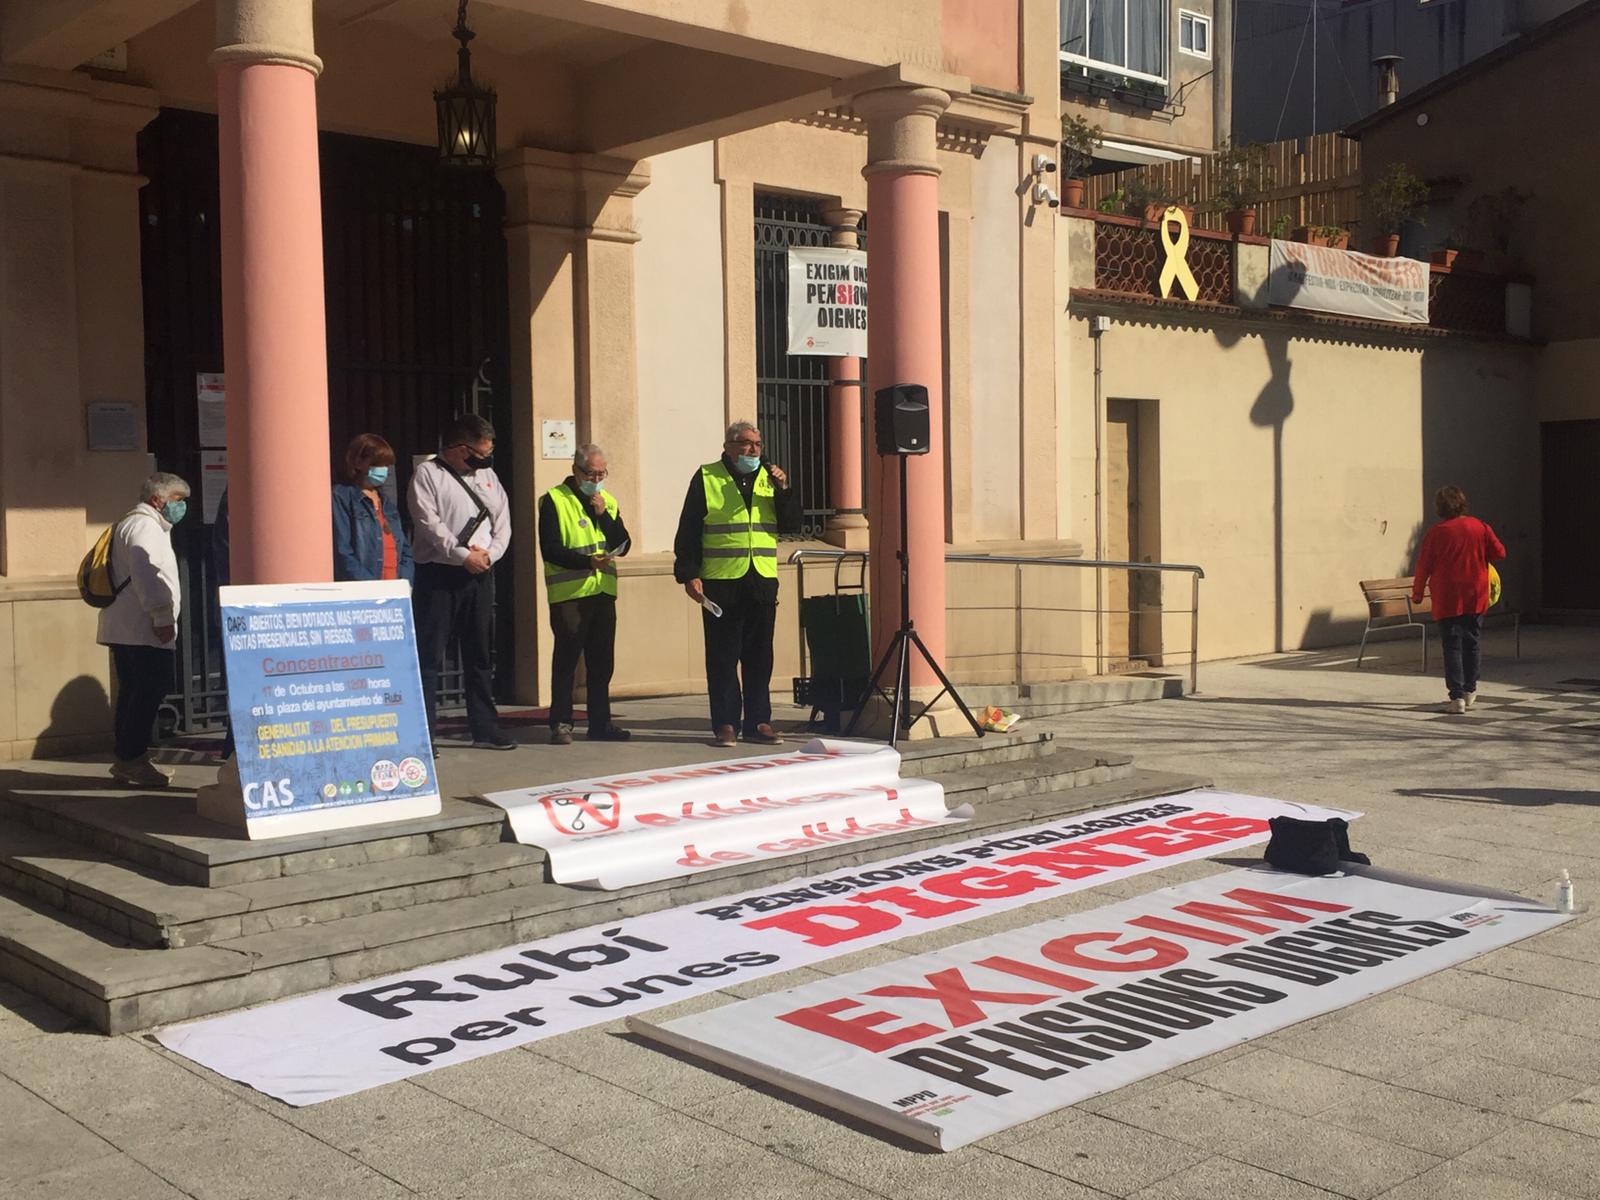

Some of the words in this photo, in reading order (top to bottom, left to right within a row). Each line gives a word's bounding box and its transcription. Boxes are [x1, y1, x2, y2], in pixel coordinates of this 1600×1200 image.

[806, 263, 850, 281] EXIGIM
[817, 307, 867, 331] DIGNES
[226, 616, 247, 633] CAPS
[249, 613, 286, 631] ABIERTOS,
[229, 632, 257, 651] VISITAS
[257, 629, 310, 649] PRESENCIALES,
[262, 652, 384, 674] Concentración
[274, 686, 286, 697] de
[289, 682, 324, 696] Octubre
[325, 683, 332, 693] a
[332, 680, 345, 692] las
[367, 677, 391, 690] horas
[252, 706, 264, 717] en
[264, 703, 274, 716] la
[277, 701, 301, 717] plaza
[301, 699, 316, 712] del
[316, 695, 372, 713] ayuntamiento
[372, 694, 383, 705] de
[257, 720, 311, 741] GENERALITAT
[330, 717, 347, 733] DEL
[346, 712, 399, 731] PRESUPUESTO
[259, 744, 272, 759] DE
[271, 740, 306, 758] SANIDAD
[313, 738, 325, 753] LA
[243, 778, 294, 810] CAS
[676, 844, 755, 868] de
[757, 808, 939, 851] calidad
[694, 853, 967, 921] PENSIONS
[740, 812, 1271, 947] DIGNES
[338, 927, 668, 1020] Rubí
[775, 887, 1354, 1053] EXIGIM
[379, 1006, 546, 1066] per
[569, 950, 781, 1008] unes
[888, 968, 1289, 1097] PENSIONS
[1208, 910, 1471, 987] DIGNES
